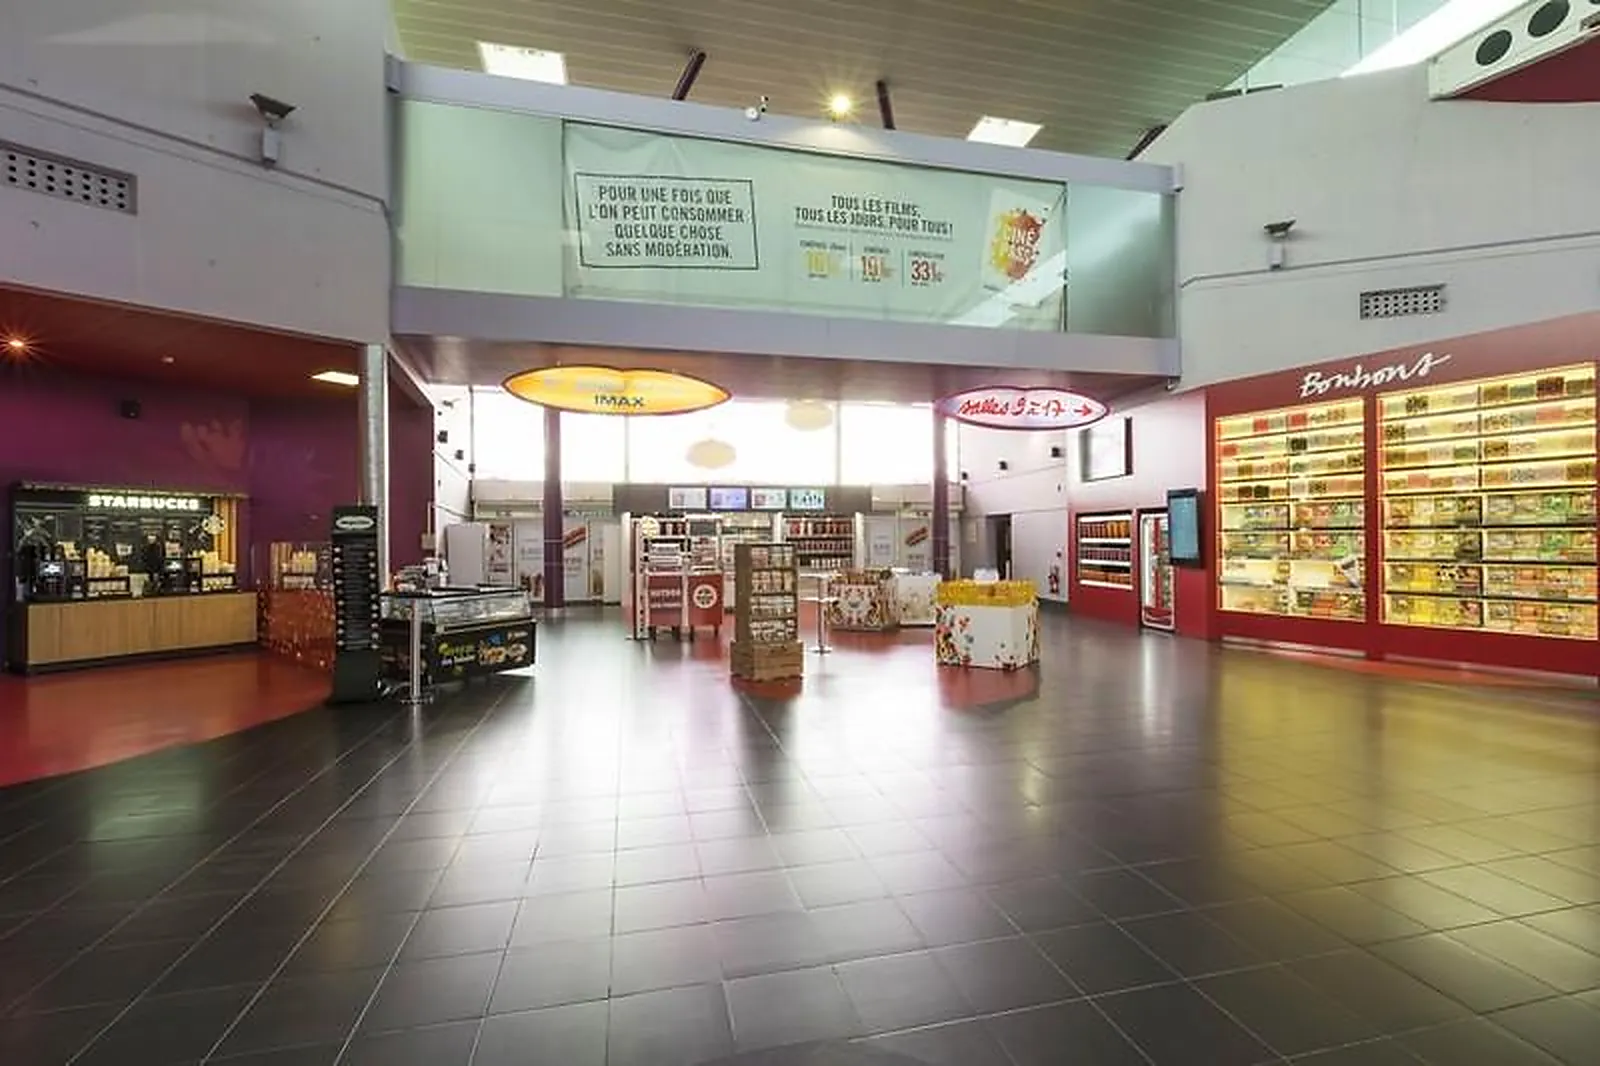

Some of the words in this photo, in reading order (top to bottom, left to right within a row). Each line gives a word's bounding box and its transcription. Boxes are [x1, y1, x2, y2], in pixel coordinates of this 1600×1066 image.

[599, 185, 636, 201] POUR
[641, 187, 667, 203] UNE
[671, 189, 702, 204] FOIS
[706, 190, 732, 205] QUE
[831, 195, 860, 211] TOUS
[863, 199, 883, 213] LES
[589, 204, 618, 219] L'ON
[623, 205, 657, 220] PEUT
[661, 206, 744, 223] CONSOMMER
[796, 207, 824, 222] TOUS
[827, 211, 847, 225] LES
[889, 216, 919, 231] POUR
[615, 223, 675, 239] QUELQUE
[680, 225, 723, 241] CHOSE
[606, 242, 641, 257] SANS
[645, 240, 733, 260] MODÉRATION.
[1300, 352, 1451, 398] Bonbons
[594, 394, 645, 408] IMAX
[89, 495, 199, 510] STARBUCKS
